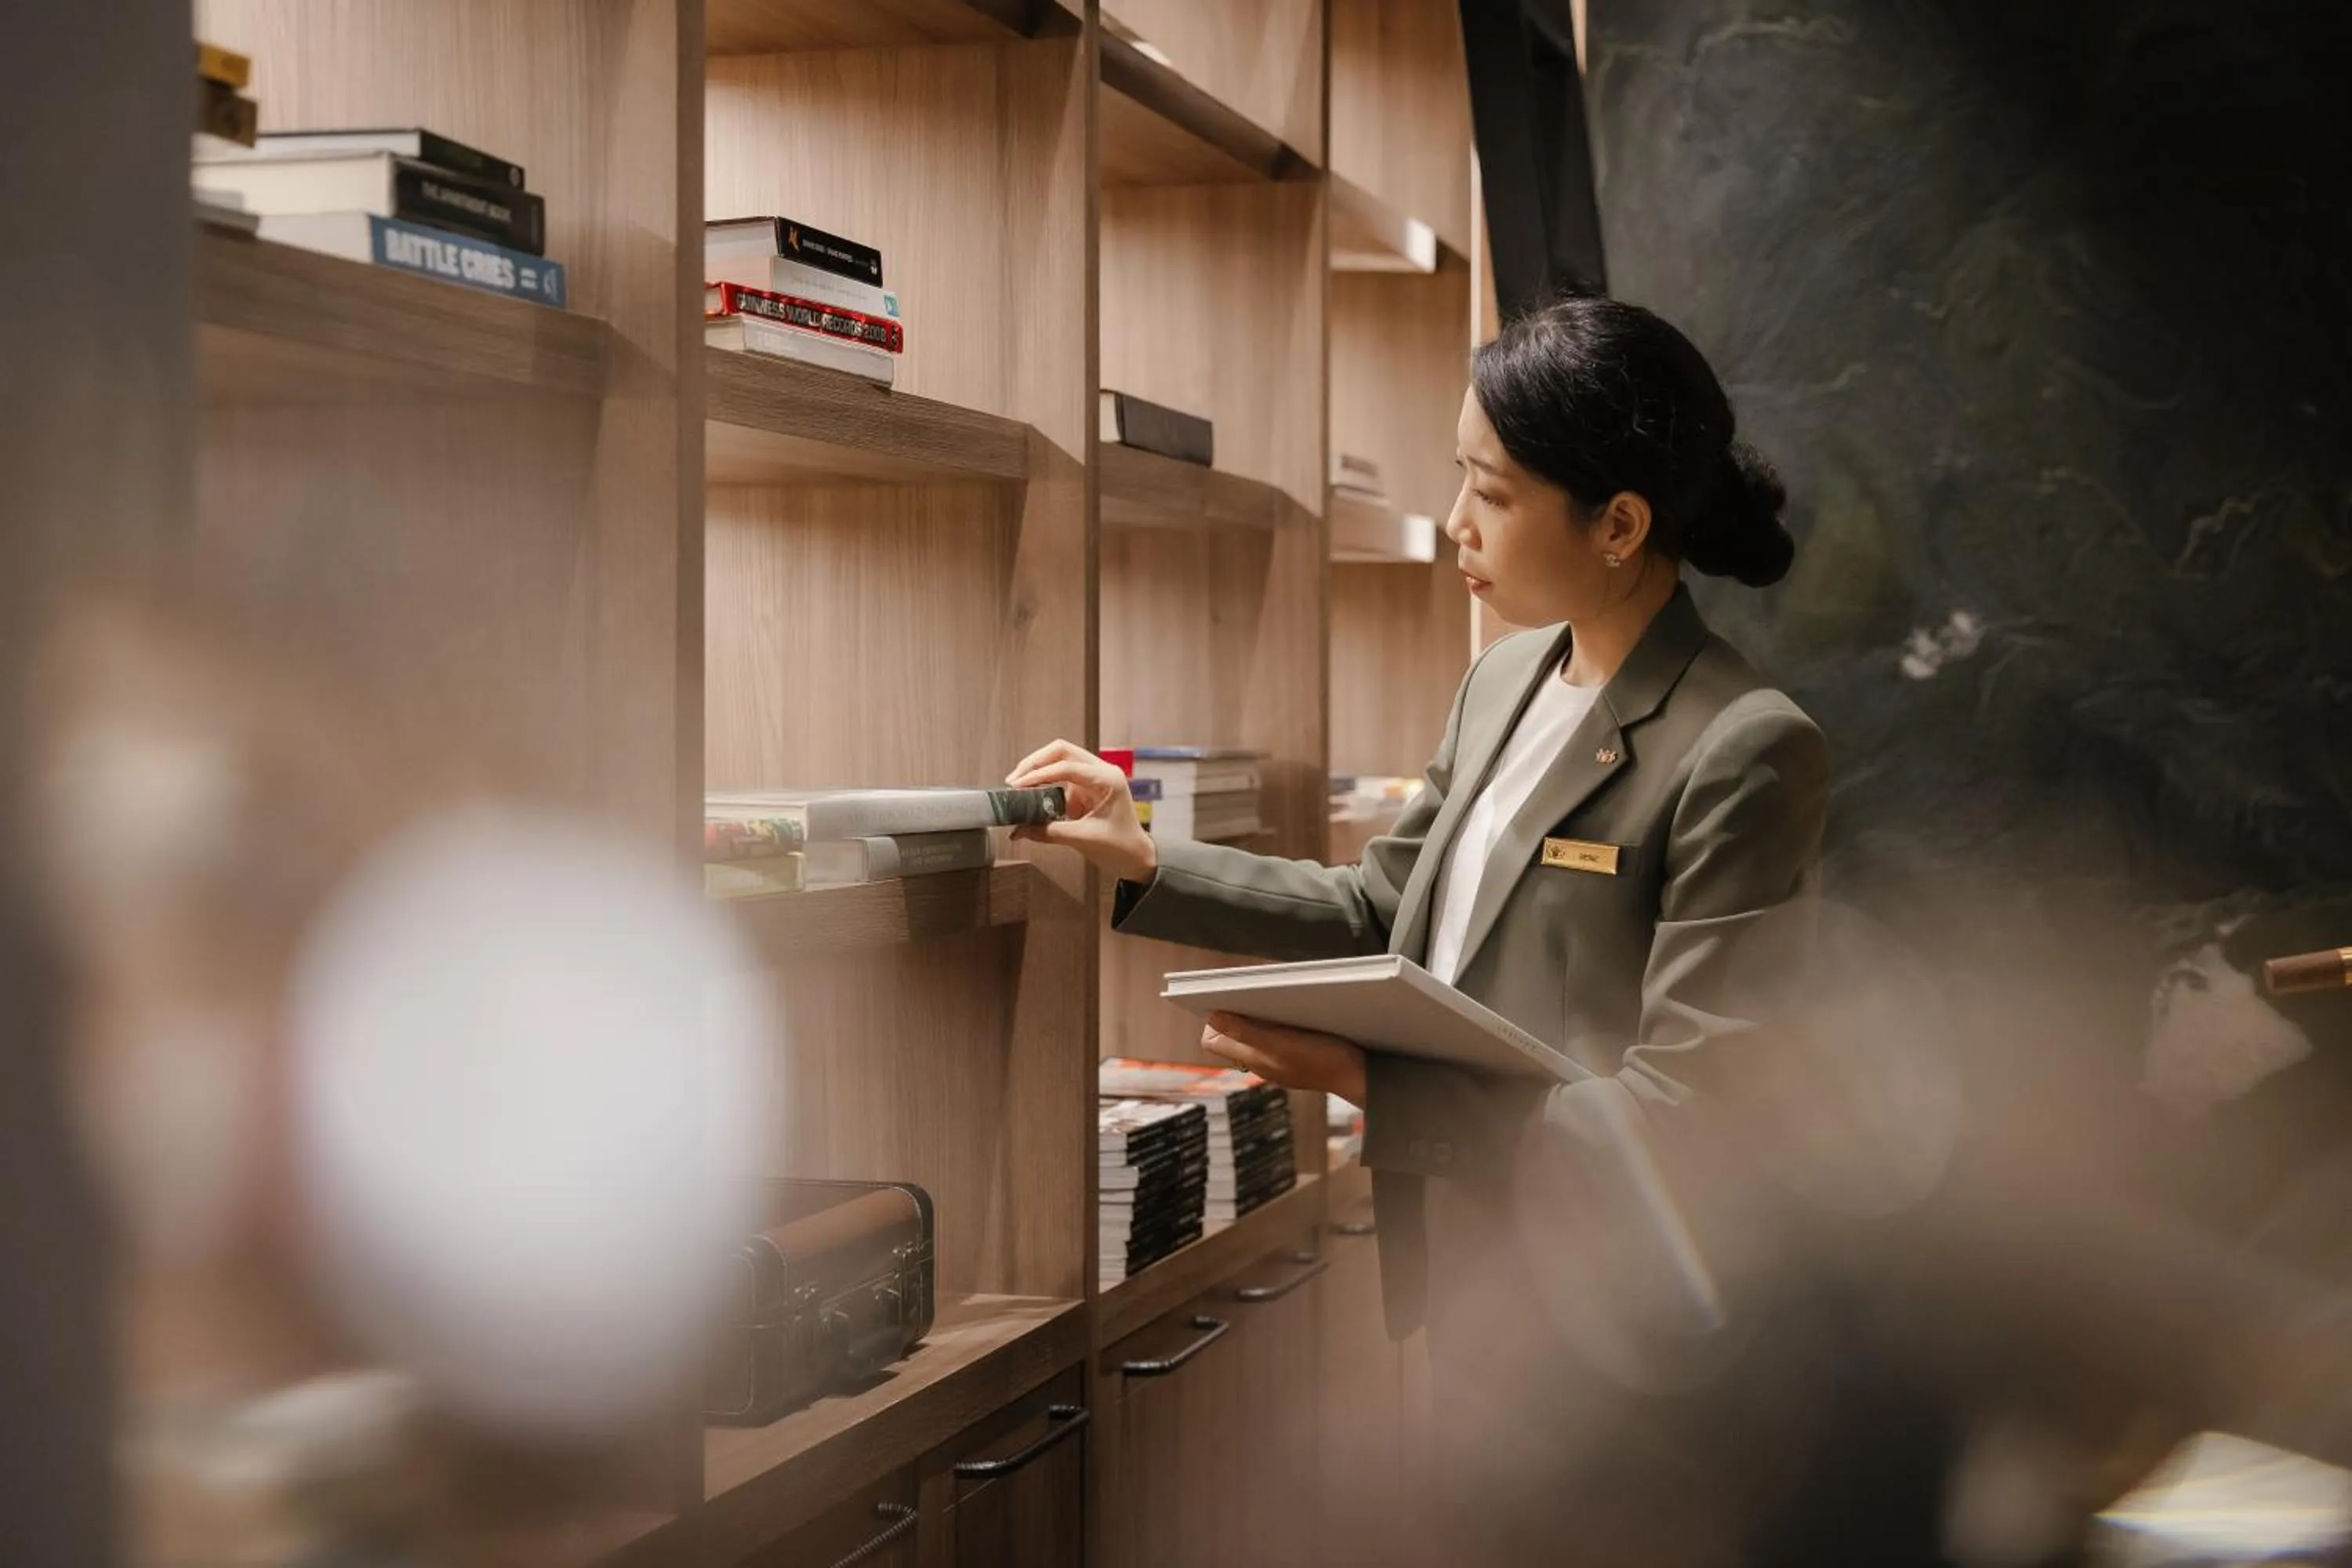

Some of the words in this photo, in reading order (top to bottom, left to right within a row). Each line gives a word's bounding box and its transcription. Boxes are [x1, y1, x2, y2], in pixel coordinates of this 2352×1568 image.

[384, 228, 460, 278] BATTLE
[460, 247, 515, 289] CRIES
[737, 292, 786, 318] GUINNESS
[786, 305, 820, 327] WORLD
[821, 313, 863, 337] RECORDS
